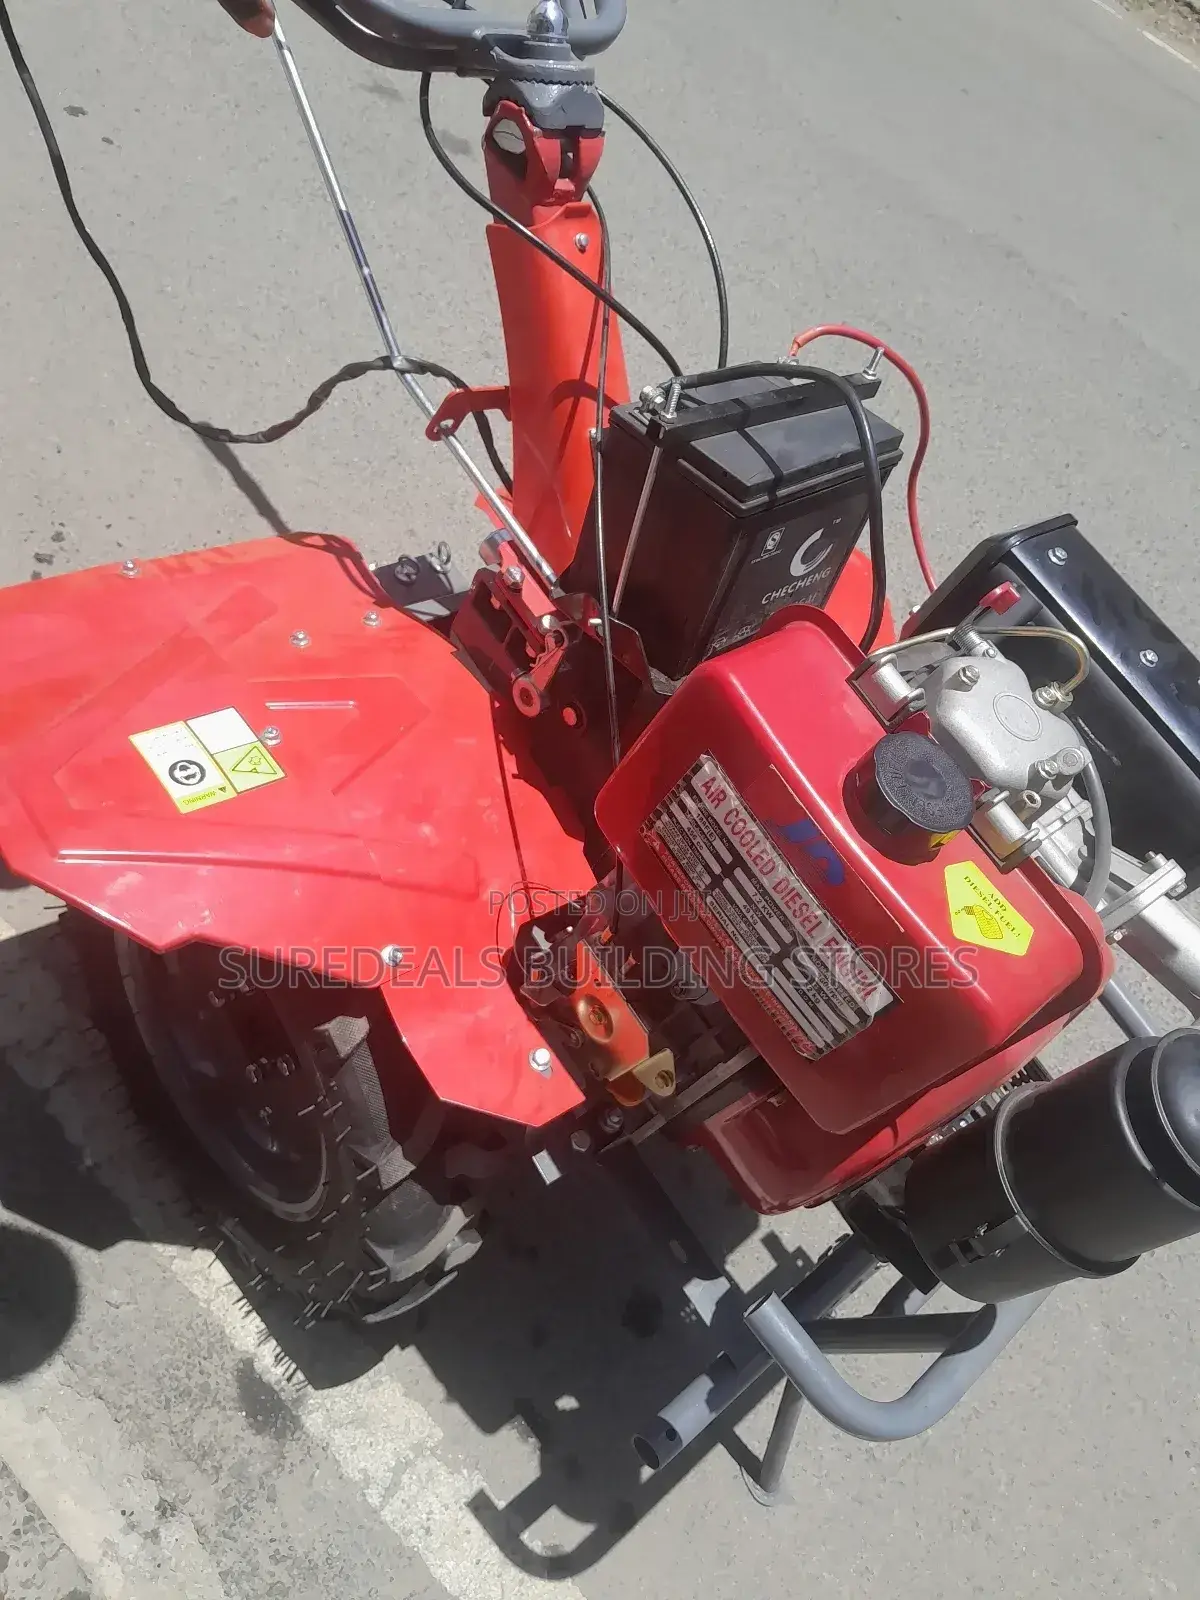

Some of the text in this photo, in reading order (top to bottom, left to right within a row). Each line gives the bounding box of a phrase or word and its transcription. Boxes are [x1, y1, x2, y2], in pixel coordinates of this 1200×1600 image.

[762, 567, 831, 604] CHECHENG
[700, 776, 727, 809] AIR
[723, 807, 776, 876] COOLED
[773, 878, 823, 937] DIESEL
[750, 877, 763, 893] MAX
[708, 900, 731, 929] SERIAL
[742, 903, 759, 925] 49 kg
[751, 891, 773, 919] 7.2 KW
[963, 875, 1021, 938] DIESEL FUEL!
[987, 892, 1007, 911] ADD
[810, 992, 821, 1004] kg
